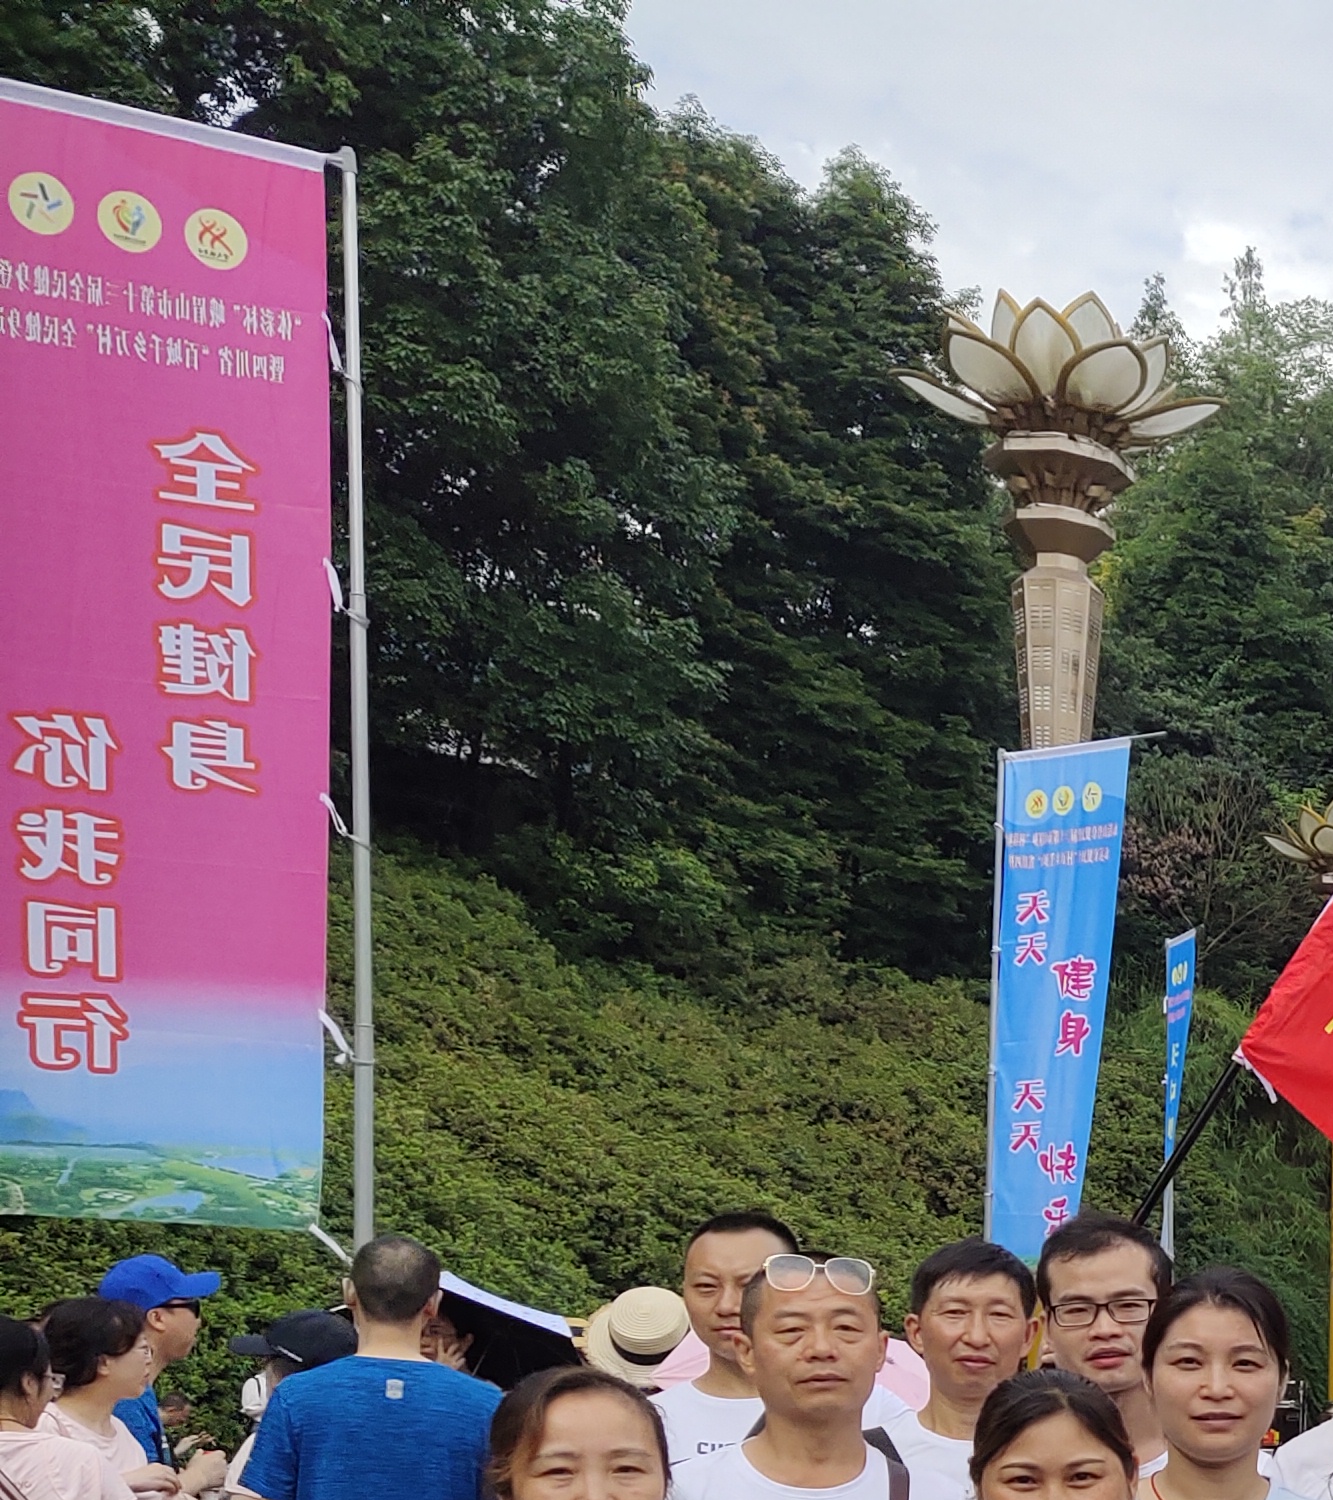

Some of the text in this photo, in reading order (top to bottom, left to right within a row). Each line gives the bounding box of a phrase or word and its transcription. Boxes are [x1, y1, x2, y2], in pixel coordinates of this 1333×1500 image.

[1014, 890, 1050, 967] 天天
[1050, 956, 1097, 1057] 健身
[1009, 1080, 1046, 1154] 天天
